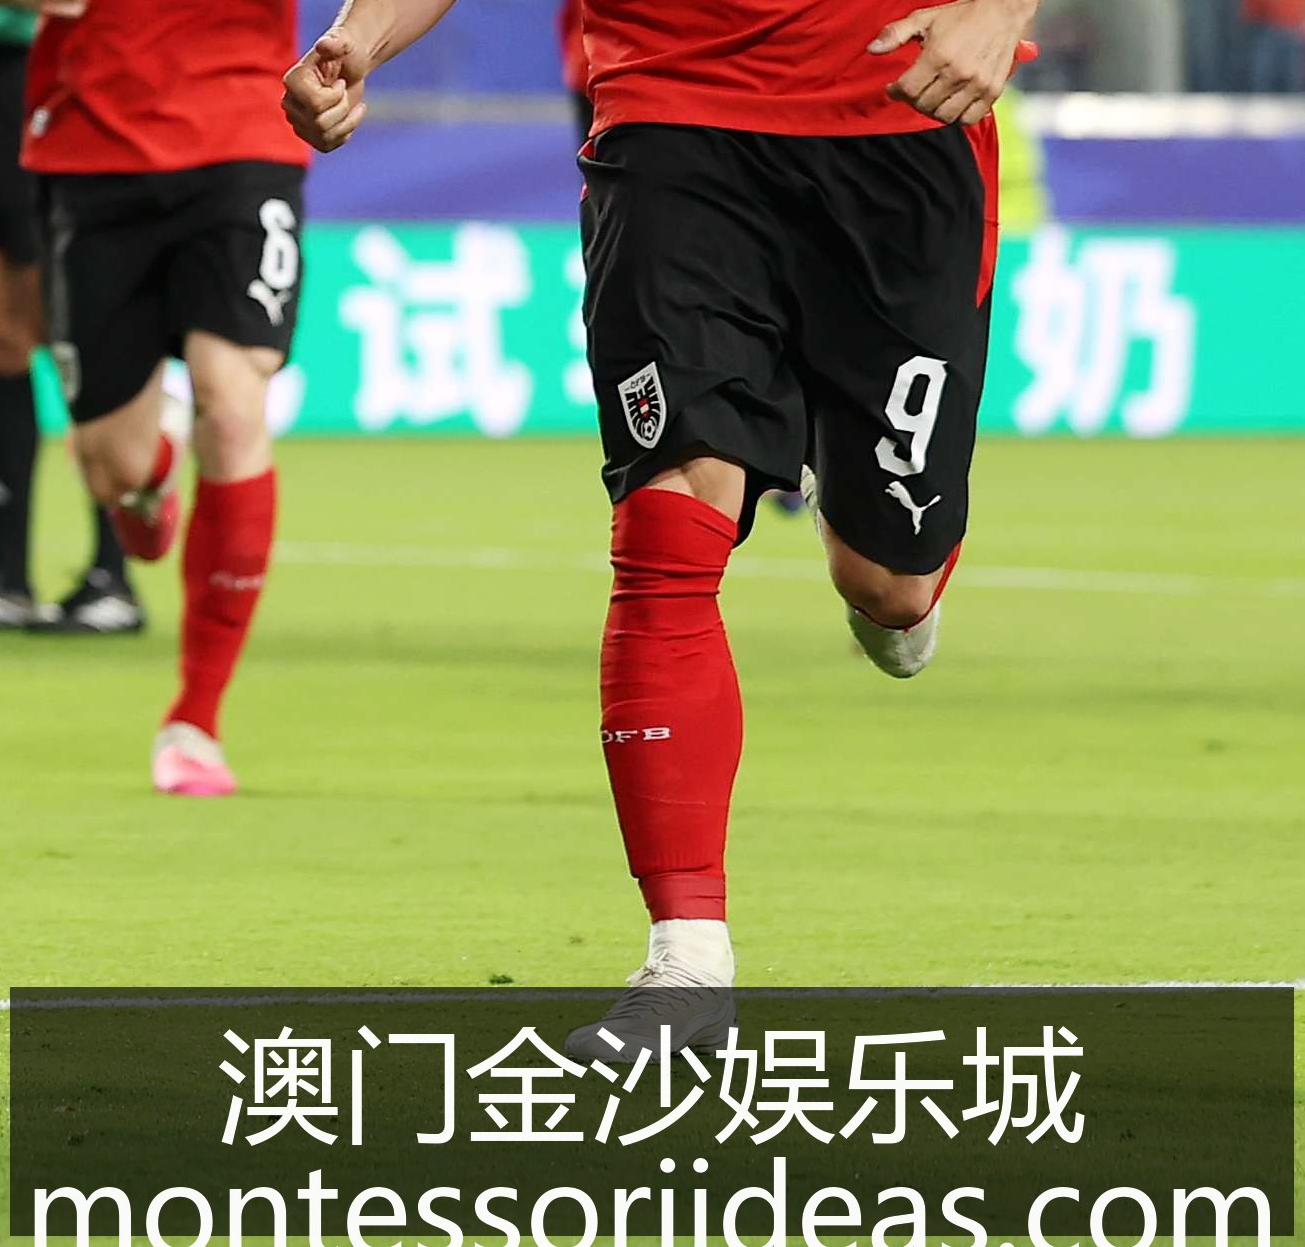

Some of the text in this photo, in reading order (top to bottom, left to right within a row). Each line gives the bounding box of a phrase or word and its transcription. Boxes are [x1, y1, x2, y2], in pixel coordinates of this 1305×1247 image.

[259, 198, 301, 289] 6
[339, 223, 535, 437] 试
[1011, 225, 1198, 439] 奶
[874, 355, 948, 478] 9
